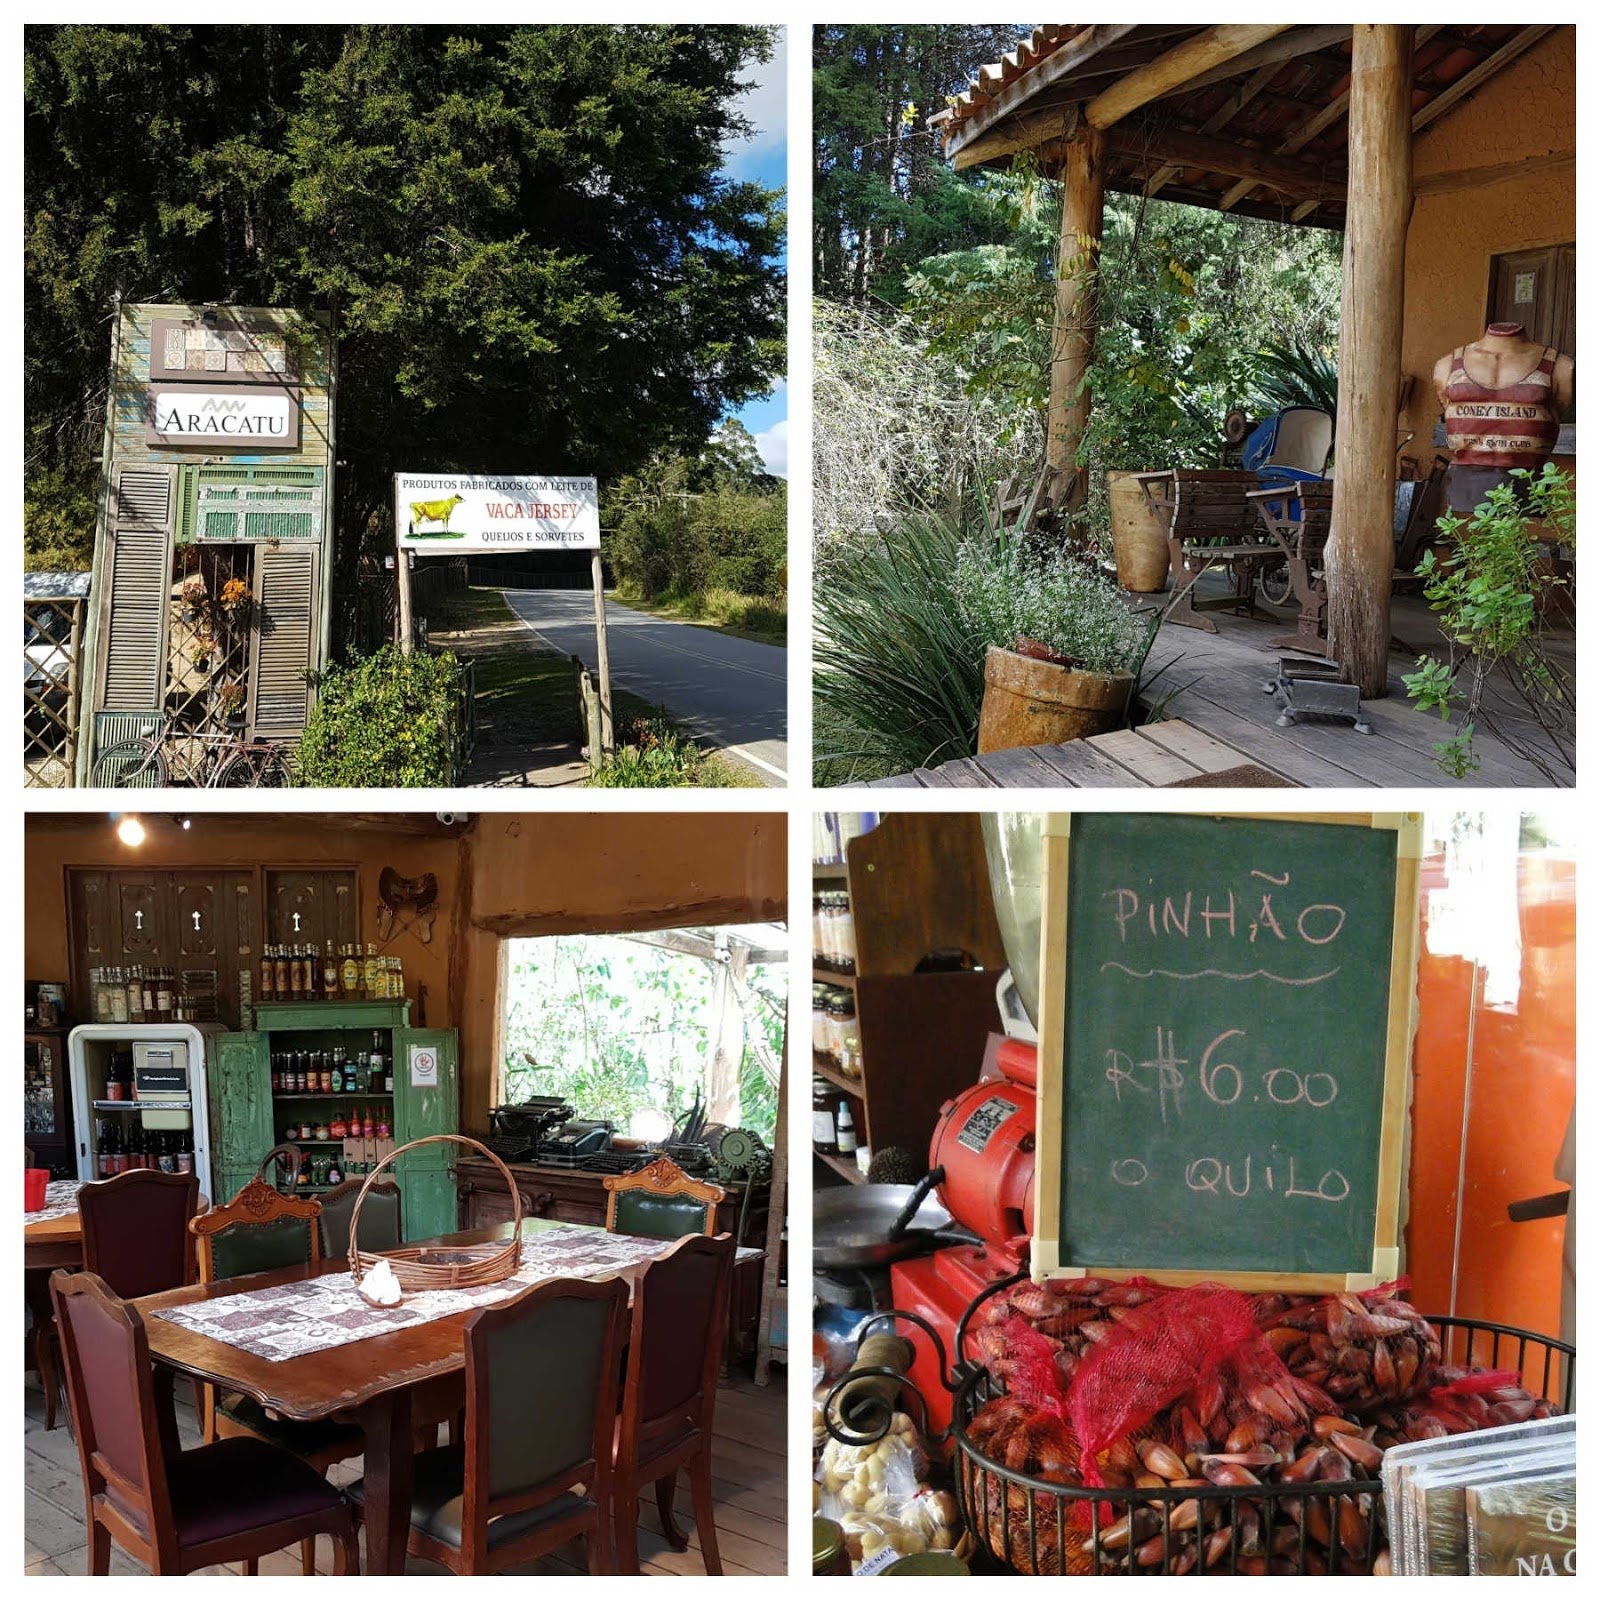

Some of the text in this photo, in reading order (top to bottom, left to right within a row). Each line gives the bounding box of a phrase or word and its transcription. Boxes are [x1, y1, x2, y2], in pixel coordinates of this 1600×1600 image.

[163, 408, 284, 434] ARACATU
[1456, 405, 1537, 419] CONEY ISLAND
[402, 479, 594, 491] PRODUTOS FABRICADOS COM LEITE DE
[485, 503, 577, 519] VACA JERSEY
[481, 531, 585, 543] QUEIJOS E SORVETES
[1101, 869, 1346, 944] PINHÃO
[1546, 1506, 1568, 1532] O
[1516, 1553, 1558, 1576] NA
